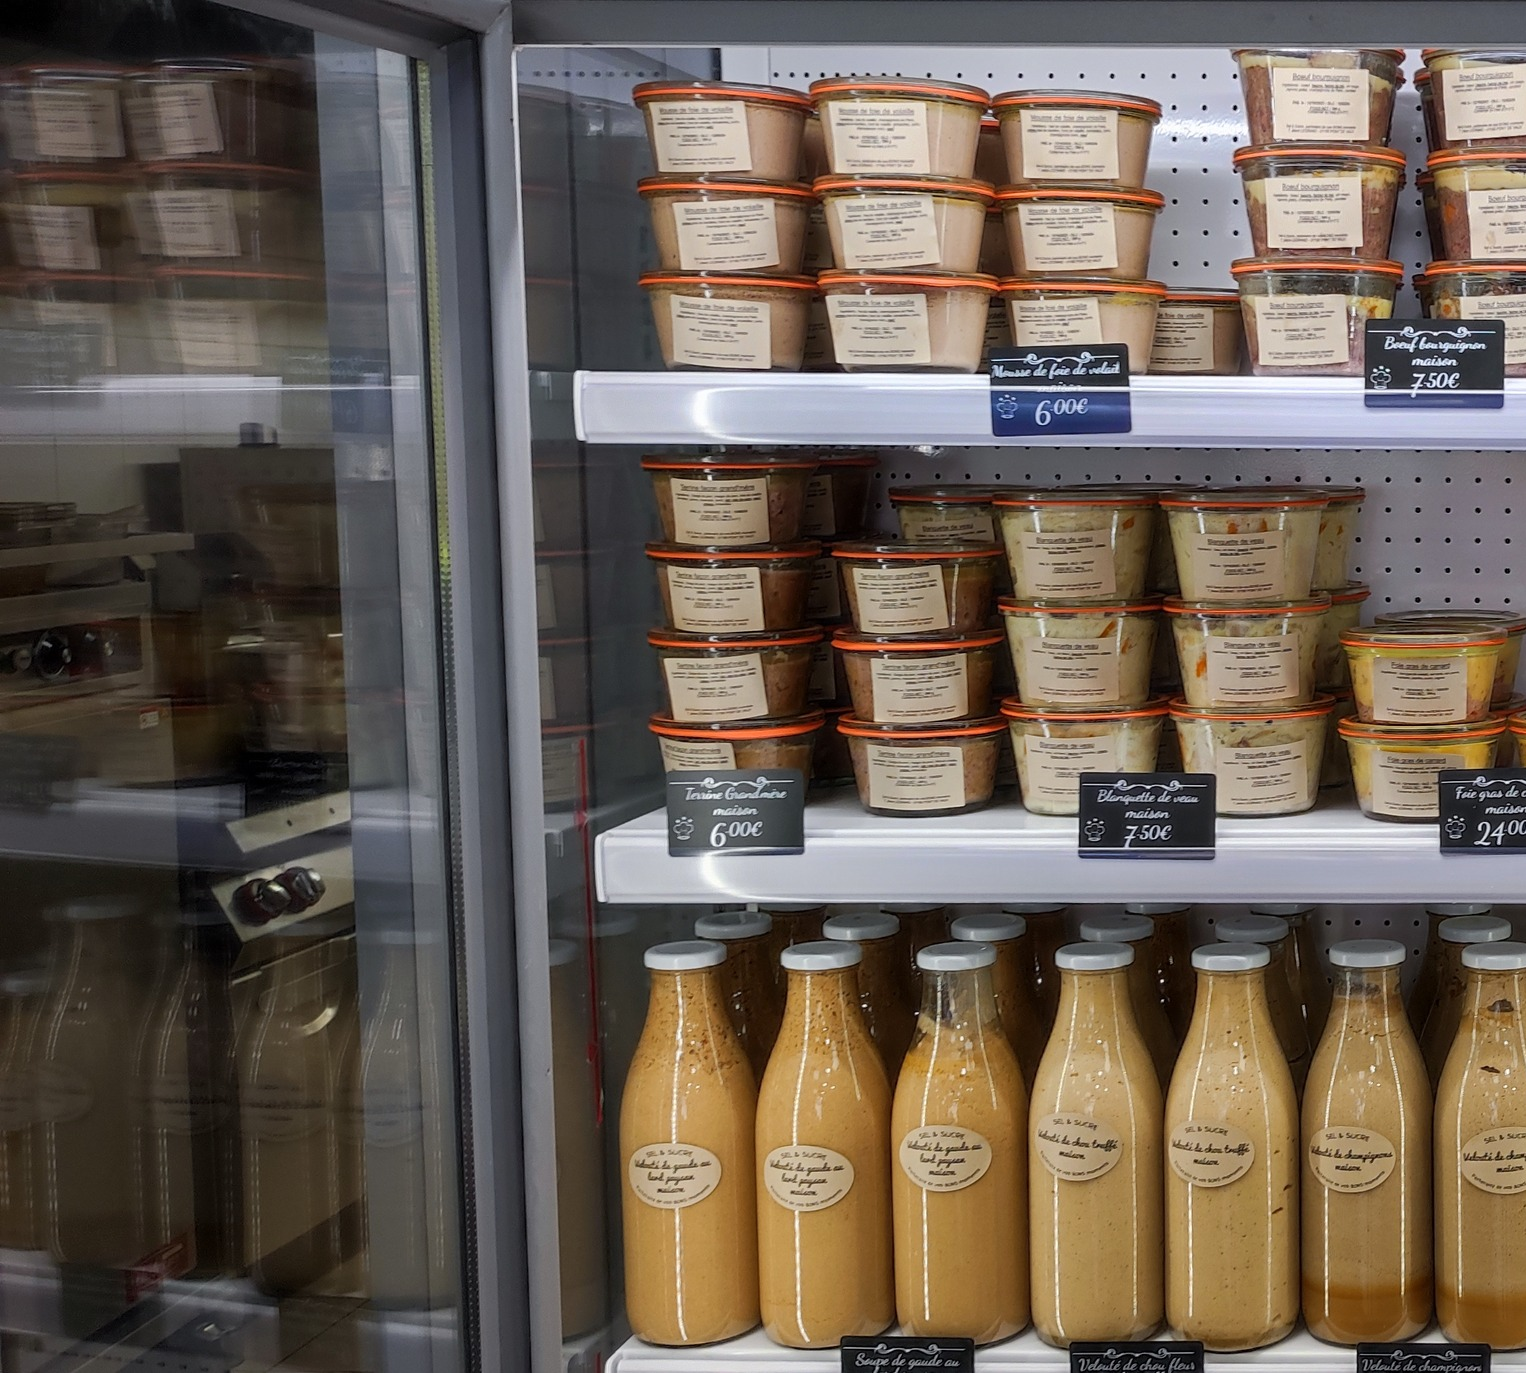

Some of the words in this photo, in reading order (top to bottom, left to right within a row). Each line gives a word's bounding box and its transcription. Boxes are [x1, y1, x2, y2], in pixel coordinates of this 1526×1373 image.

[1419, 337, 1486, 353] bourguignon
[1411, 355, 1458, 366] maison
[991, 364, 1032, 378] Mousse
[1033, 364, 1047, 377] de
[1048, 363, 1070, 379] foie
[1072, 362, 1087, 375] de
[685, 787, 723, 800] Terrine
[1097, 789, 1156, 805] Blanquette
[1157, 791, 1171, 803] de
[1455, 786, 1477, 800] Foie
[1479, 790, 1503, 802] gras
[1505, 785, 1519, 798] de
[712, 805, 759, 816] maison
[1125, 807, 1170, 819] maison
[855, 1352, 890, 1368] Soupe
[891, 1354, 907, 1367] de
[908, 1354, 942, 1370] gaude
[1079, 1358, 1121, 1372] Velouté
[1122, 1358, 1137, 1372] de
[1139, 1358, 1167, 1372] chou
[1362, 1358, 1401, 1372] Velouté
[1403, 1359, 1417, 1372] de
